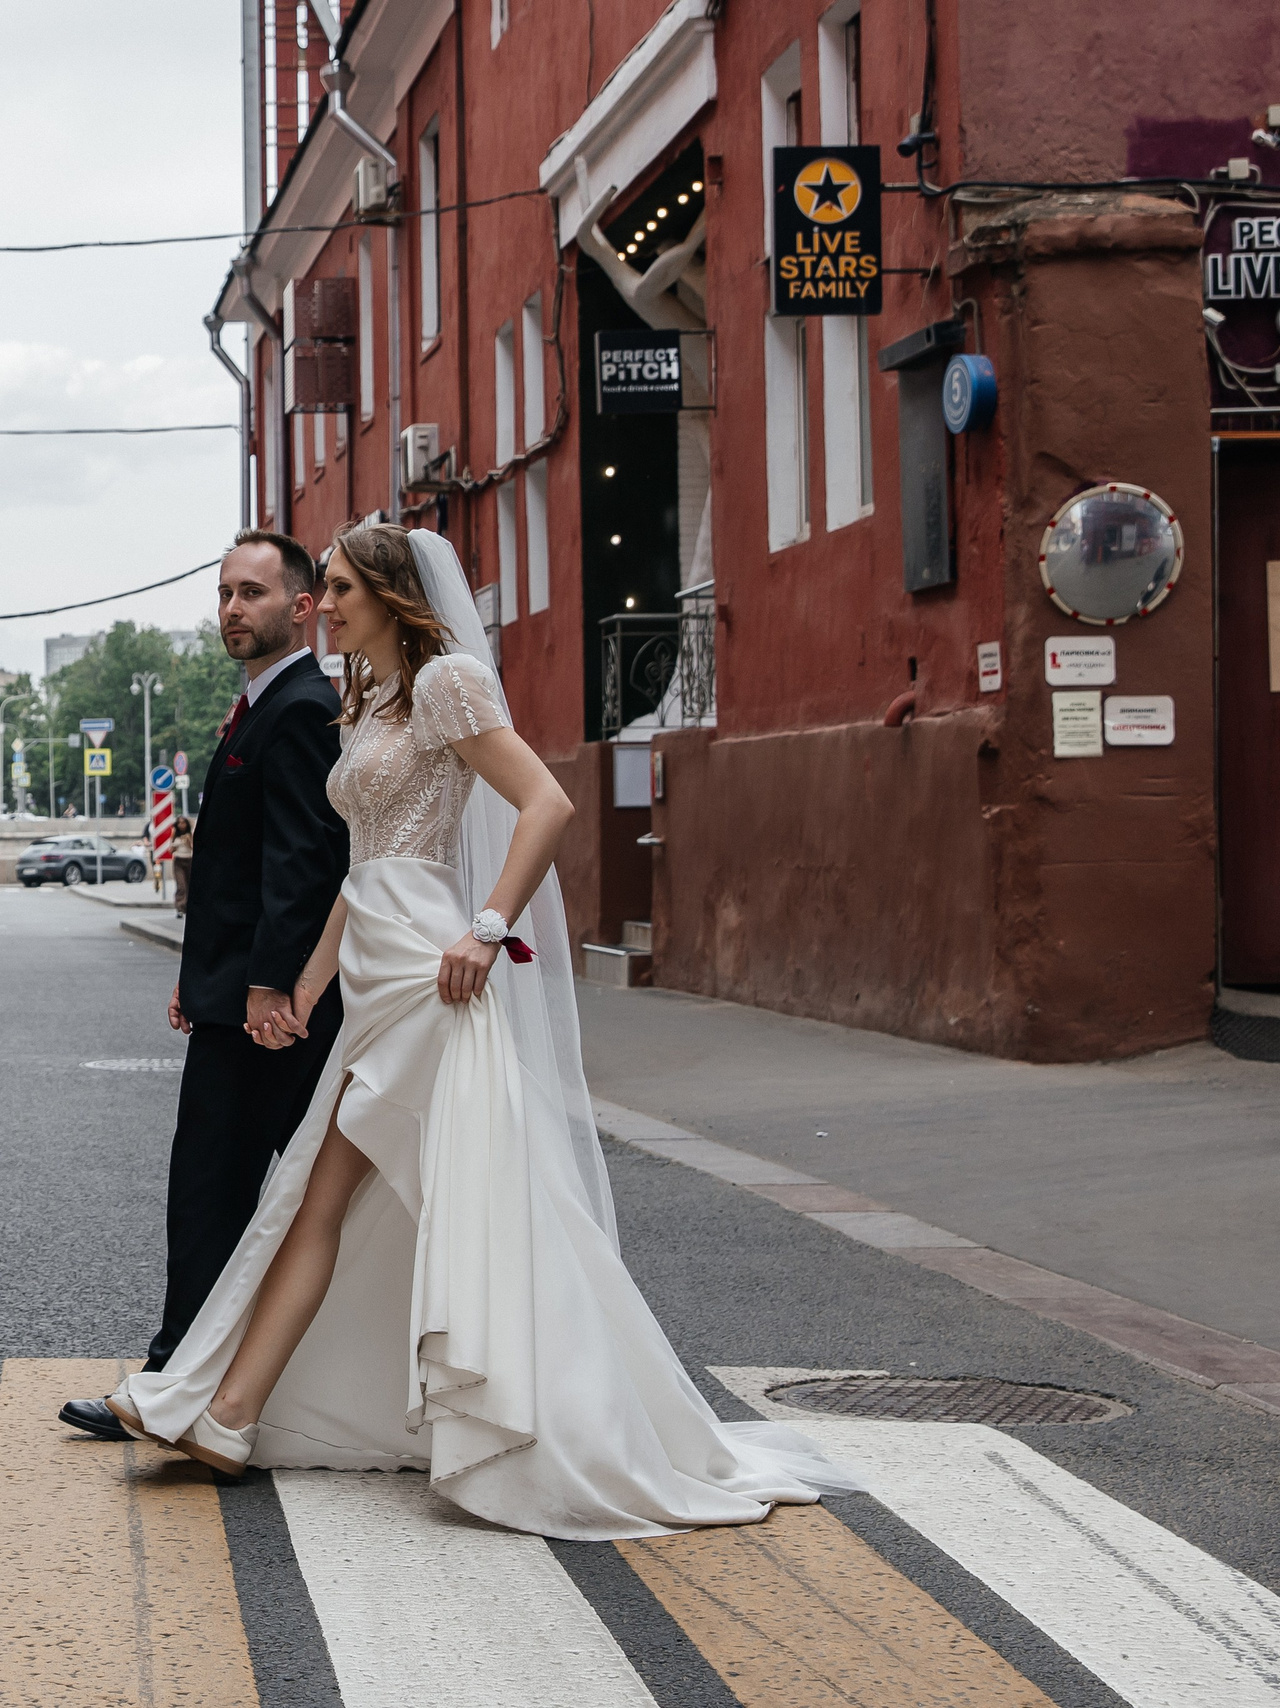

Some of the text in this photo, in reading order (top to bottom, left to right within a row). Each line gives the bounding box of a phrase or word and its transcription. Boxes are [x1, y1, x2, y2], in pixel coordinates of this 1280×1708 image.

[1232, 216, 1280, 250] PE
[780, 255, 878, 279] STARS
[1204, 253, 1280, 300] LIV
[789, 281, 870, 299] FAMILY
[601, 348, 678, 362] PERFECT
